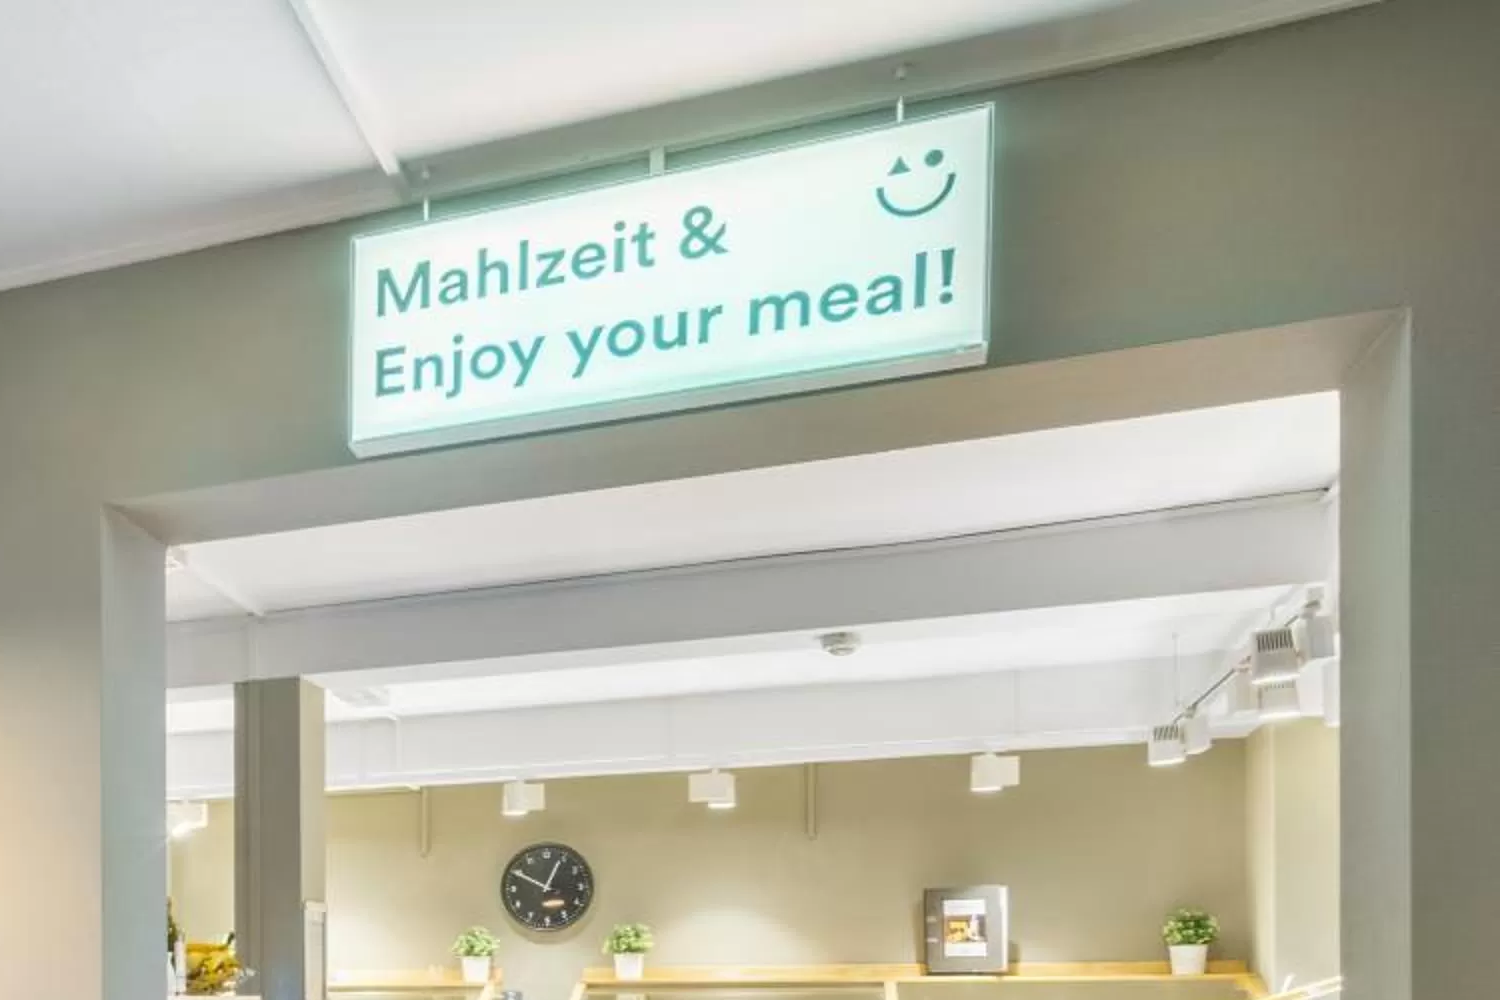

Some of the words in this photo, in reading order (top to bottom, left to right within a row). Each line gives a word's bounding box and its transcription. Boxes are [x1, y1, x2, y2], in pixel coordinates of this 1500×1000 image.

[375, 335, 545, 398] Enjoy
[566, 304, 723, 379] your
[748, 247, 957, 337] meal!
[376, 222, 655, 318] Mahlzeit
[679, 206, 729, 259] &
